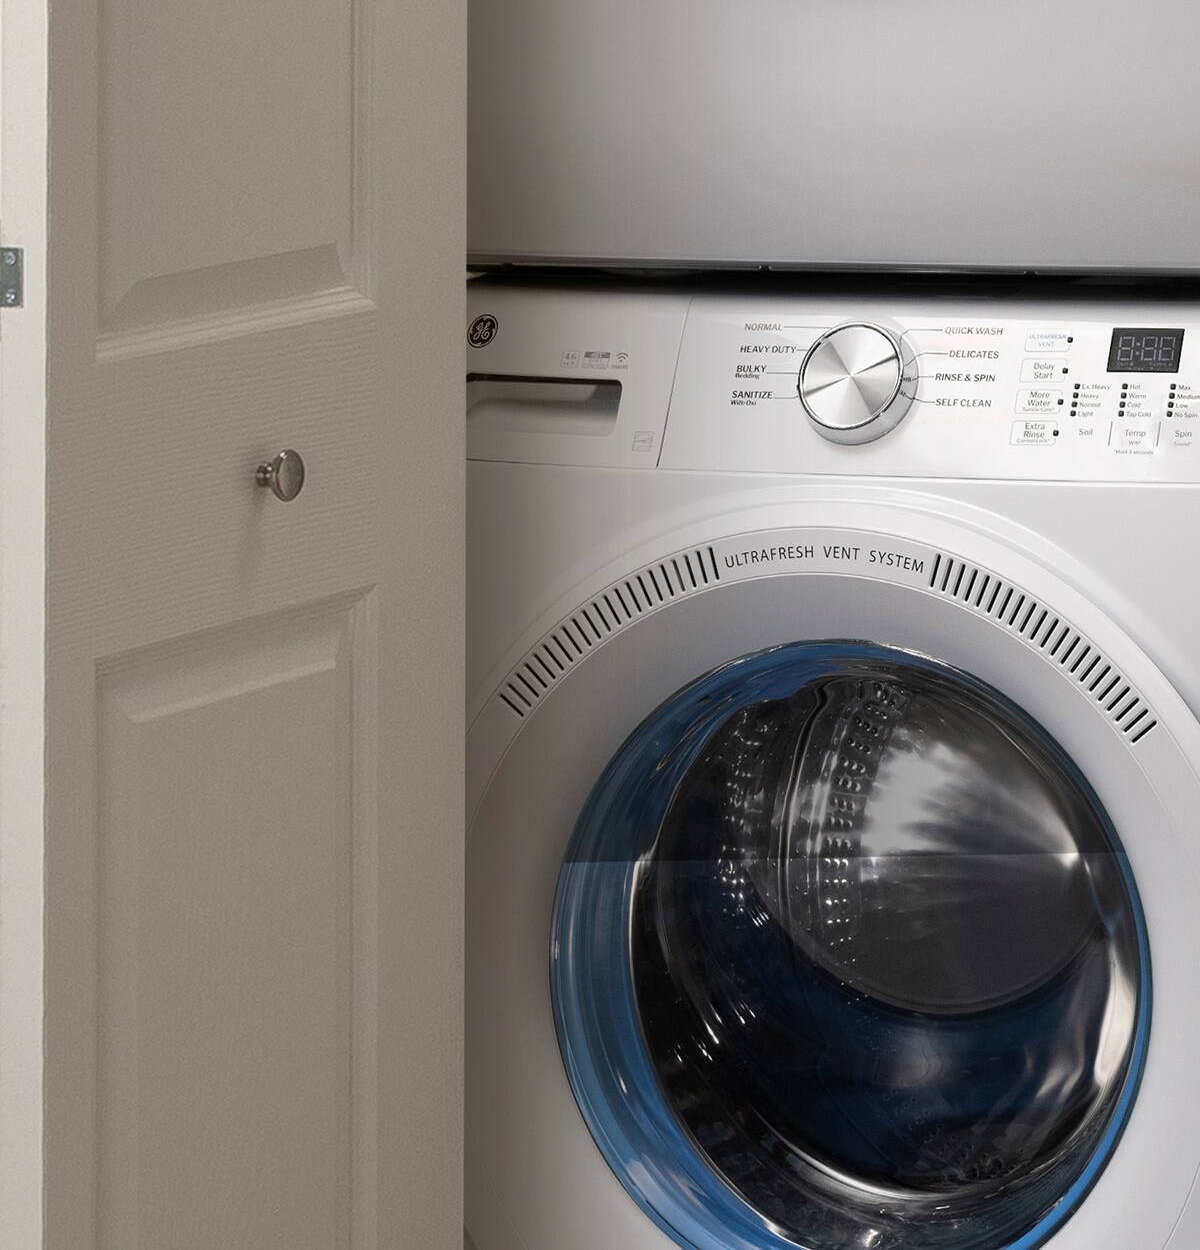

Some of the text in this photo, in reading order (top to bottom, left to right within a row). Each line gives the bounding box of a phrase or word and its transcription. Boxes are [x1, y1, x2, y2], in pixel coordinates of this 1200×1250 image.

[744, 323, 783, 331] NORMAL
[944, 327, 1004, 336] QUICK WASH
[740, 345, 797, 354] HEAVY DUTY
[1117, 336, 1176, 361] 8:88
[948, 350, 999, 359] DELICATES
[736, 365, 767, 373] BULKY
[1033, 362, 1056, 371] Delay
[935, 373, 996, 382] RINSE & SPIN
[1033, 371, 1053, 380] Start
[731, 390, 773, 399] SANITIZE
[1029, 391, 1050, 399] More
[935, 398, 992, 408] SELF CLEAN
[1027, 398, 1051, 407] Water
[1025, 422, 1045, 431] Extra
[1023, 431, 1045, 439] Rinse
[1078, 428, 1093, 436] Soil
[1124, 430, 1146, 438] Temp
[1174, 430, 1193, 438] Spin
[725, 545, 924, 573] ULTRAFRESH VENT SYSTEM
